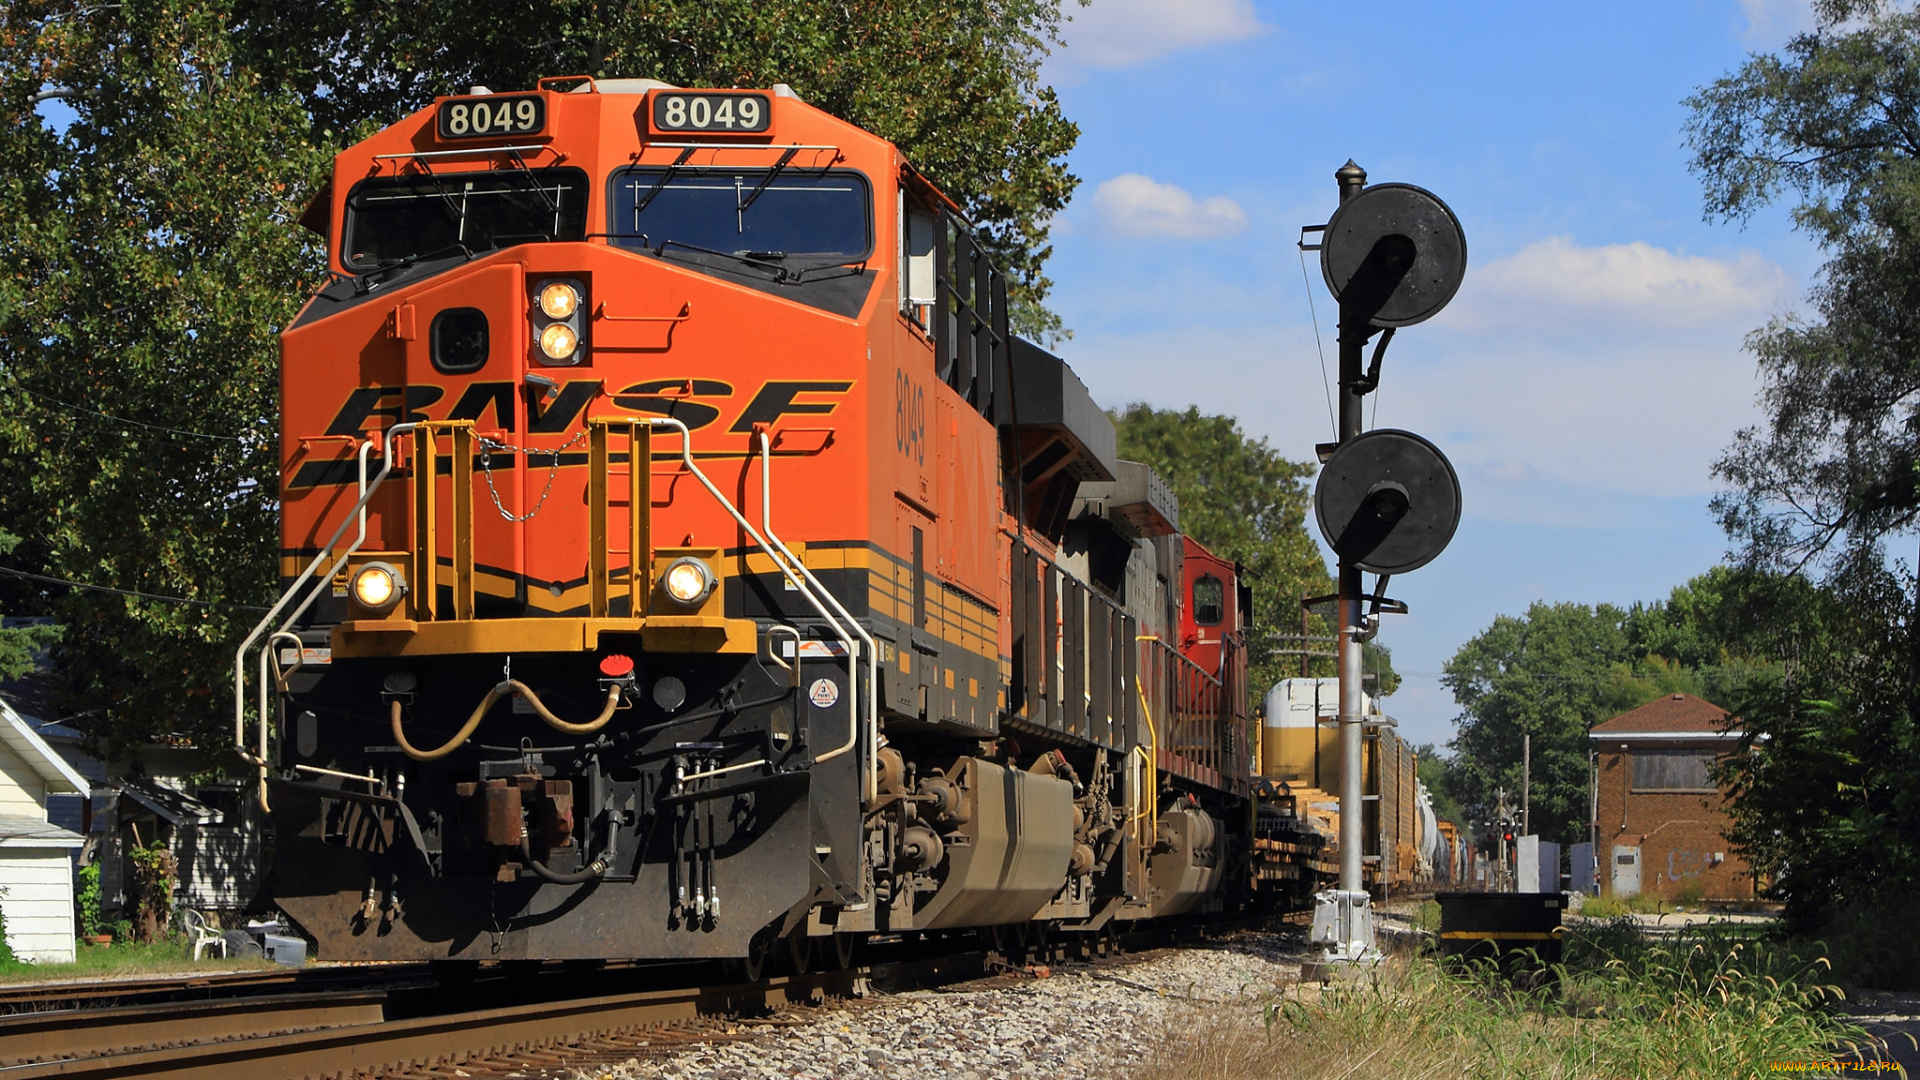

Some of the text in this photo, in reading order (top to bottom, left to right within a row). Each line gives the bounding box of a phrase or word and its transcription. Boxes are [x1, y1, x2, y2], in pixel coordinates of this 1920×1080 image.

[449, 99, 536, 135] 8049
[665, 96, 760, 129] 8049
[316, 377, 857, 443] BNSF
[895, 366, 925, 468] 8049
